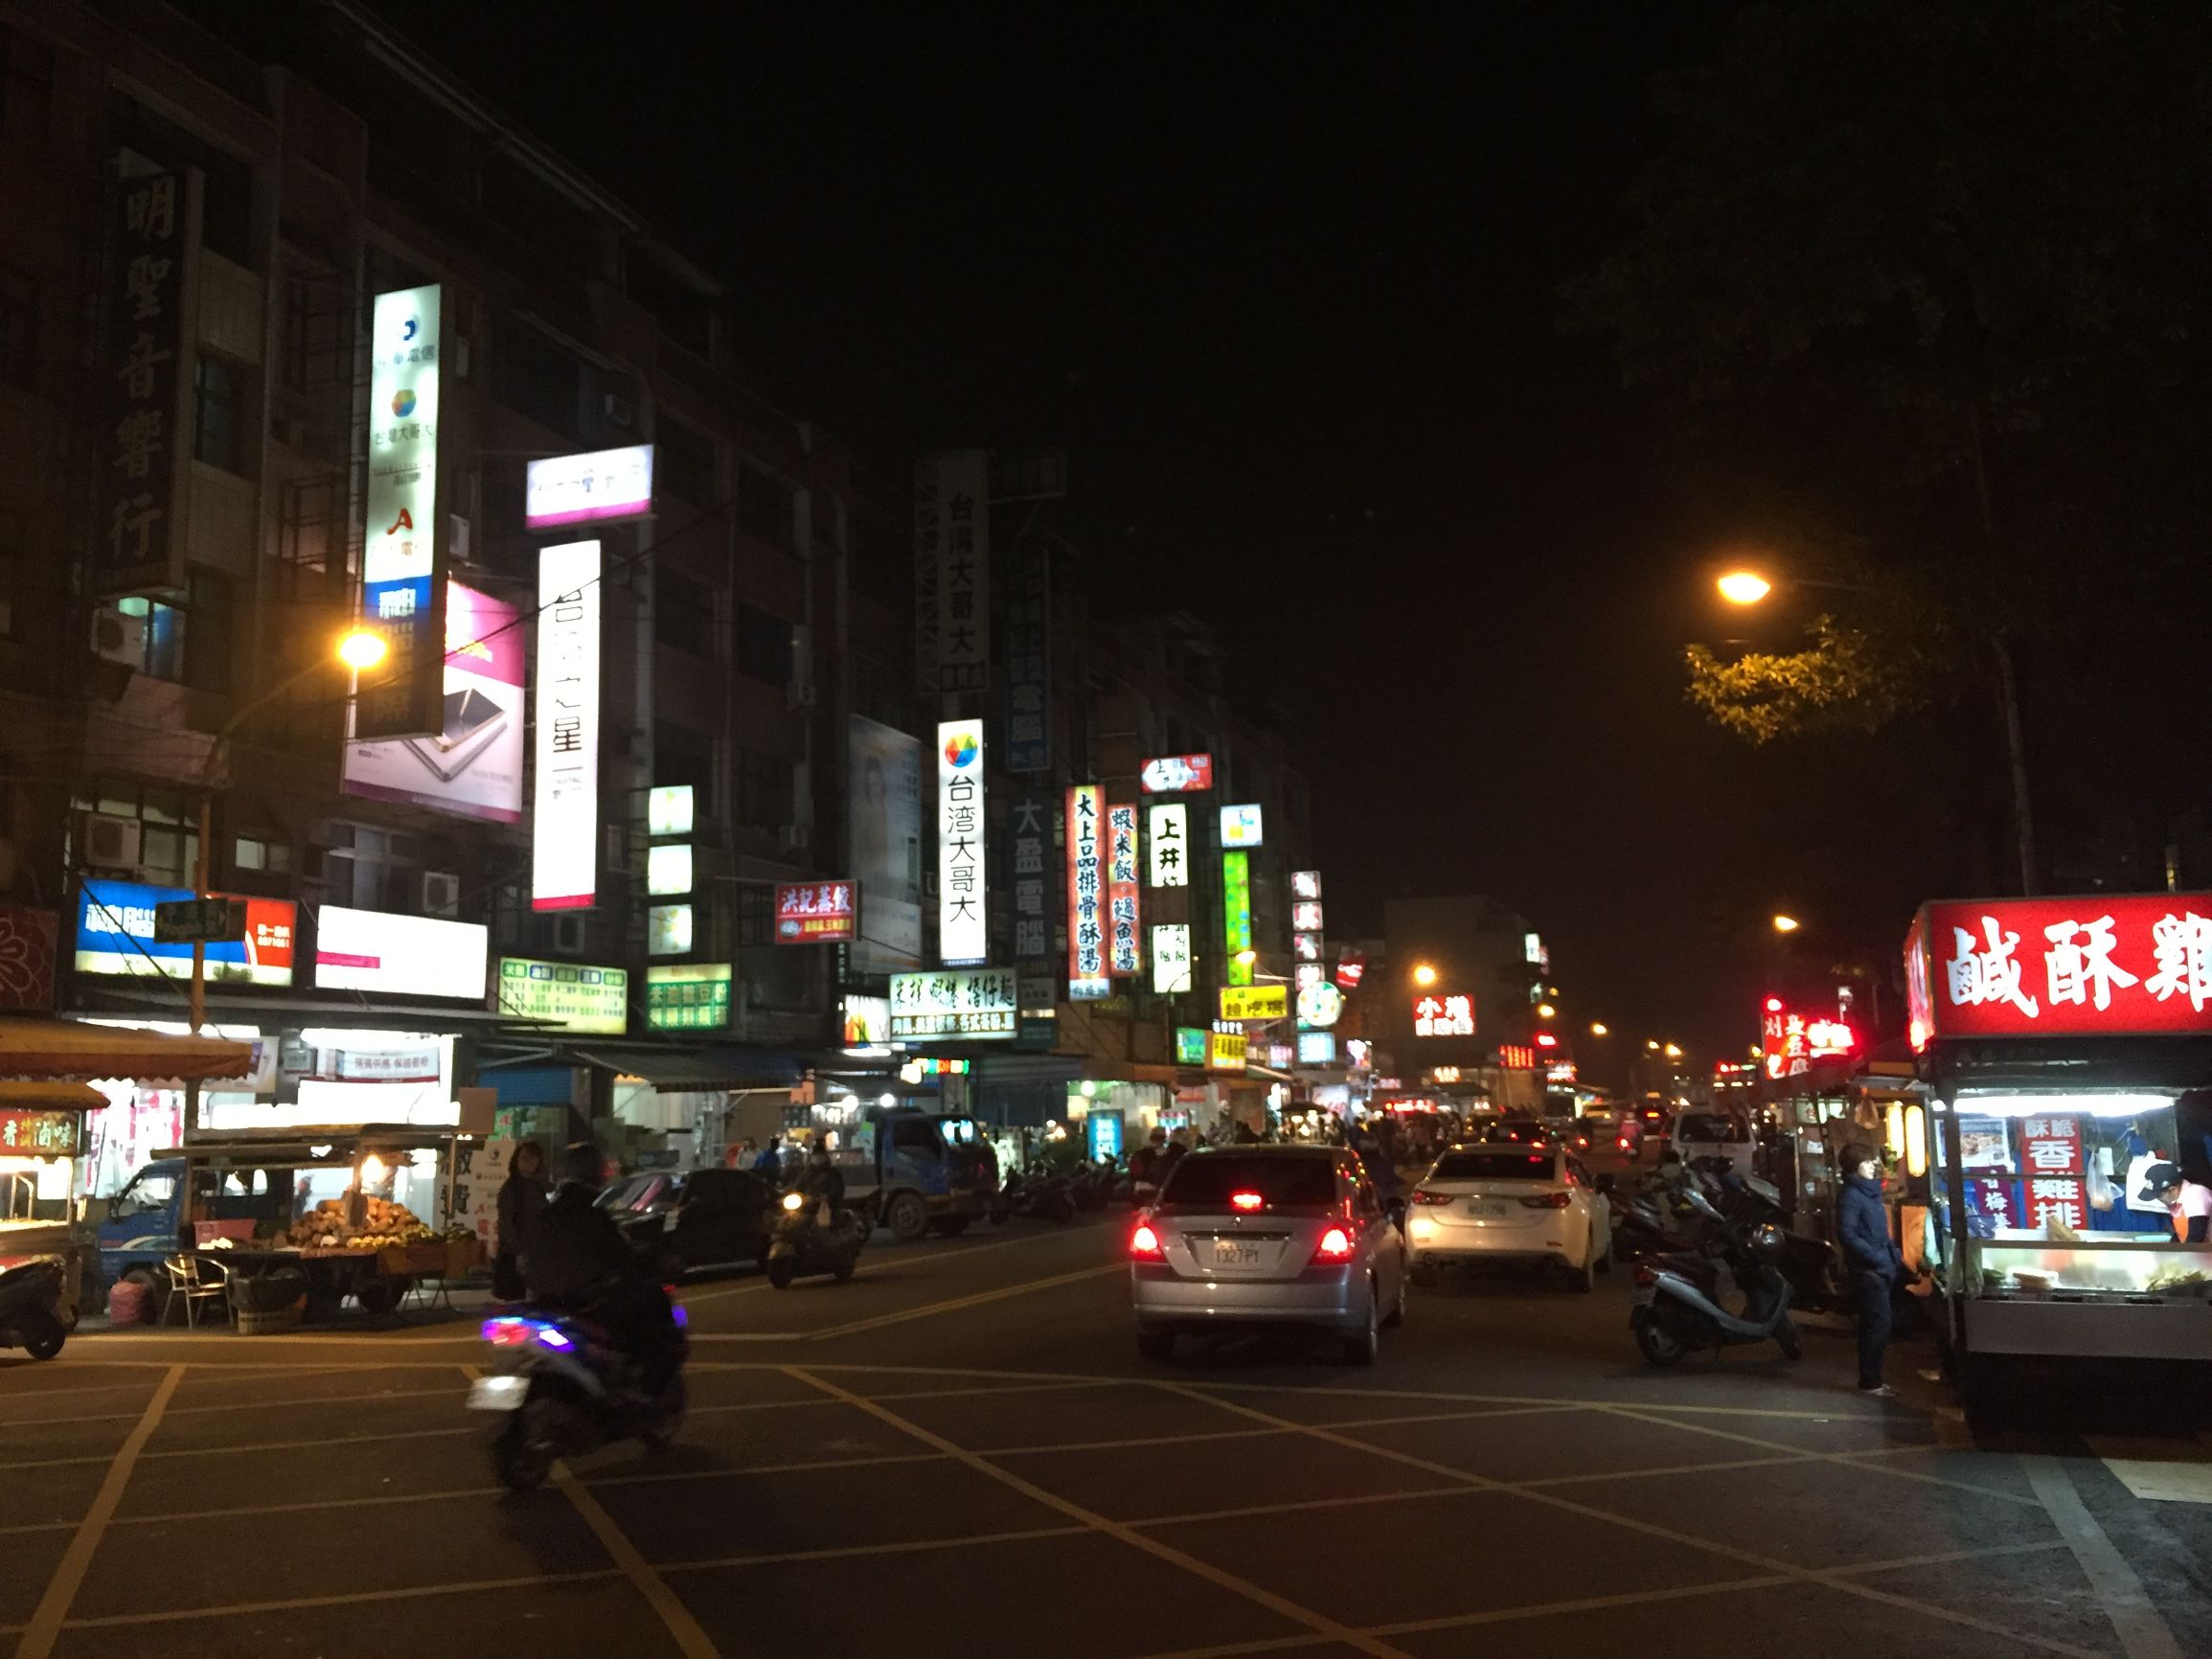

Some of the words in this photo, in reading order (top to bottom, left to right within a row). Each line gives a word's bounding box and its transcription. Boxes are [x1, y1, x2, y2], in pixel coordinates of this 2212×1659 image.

[107, 175, 176, 561] 明聖音響行
[1014, 799, 1045, 956] 大盈電腦
[1077, 793, 1101, 973] 大上品排骨酥湯
[1946, 911, 2212, 1018] 鹹酥雞
[2028, 1140, 2082, 1229] 香雞排
